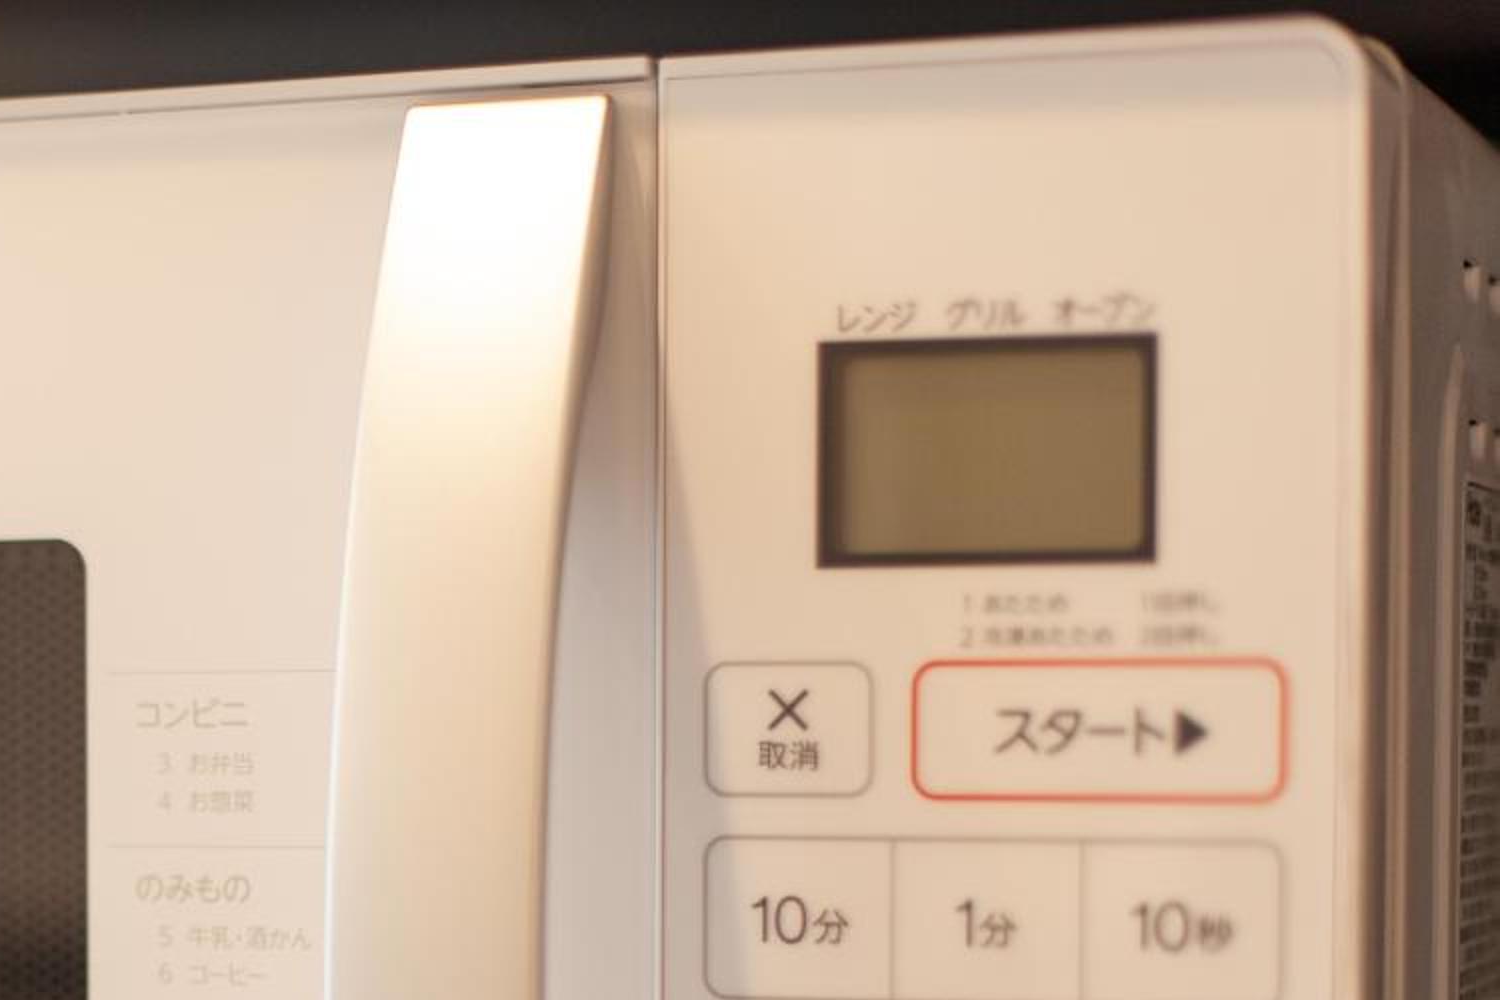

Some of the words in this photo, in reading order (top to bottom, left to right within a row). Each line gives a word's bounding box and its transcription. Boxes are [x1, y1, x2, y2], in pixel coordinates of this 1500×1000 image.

[836, 302, 918, 334] レンジ
[945, 296, 1029, 332] グリル
[136, 699, 248, 729] コンビニ
[994, 707, 1166, 756] スタート
[156, 752, 172, 776] 3
[758, 740, 820, 772] 取消
[135, 874, 251, 904] のみもの
[751, 895, 850, 946] 10分
[955, 898, 1018, 949] 1分
[1130, 900, 1236, 954] 10秒
[157, 926, 173, 948] 5
[157, 965, 173, 986] 6
